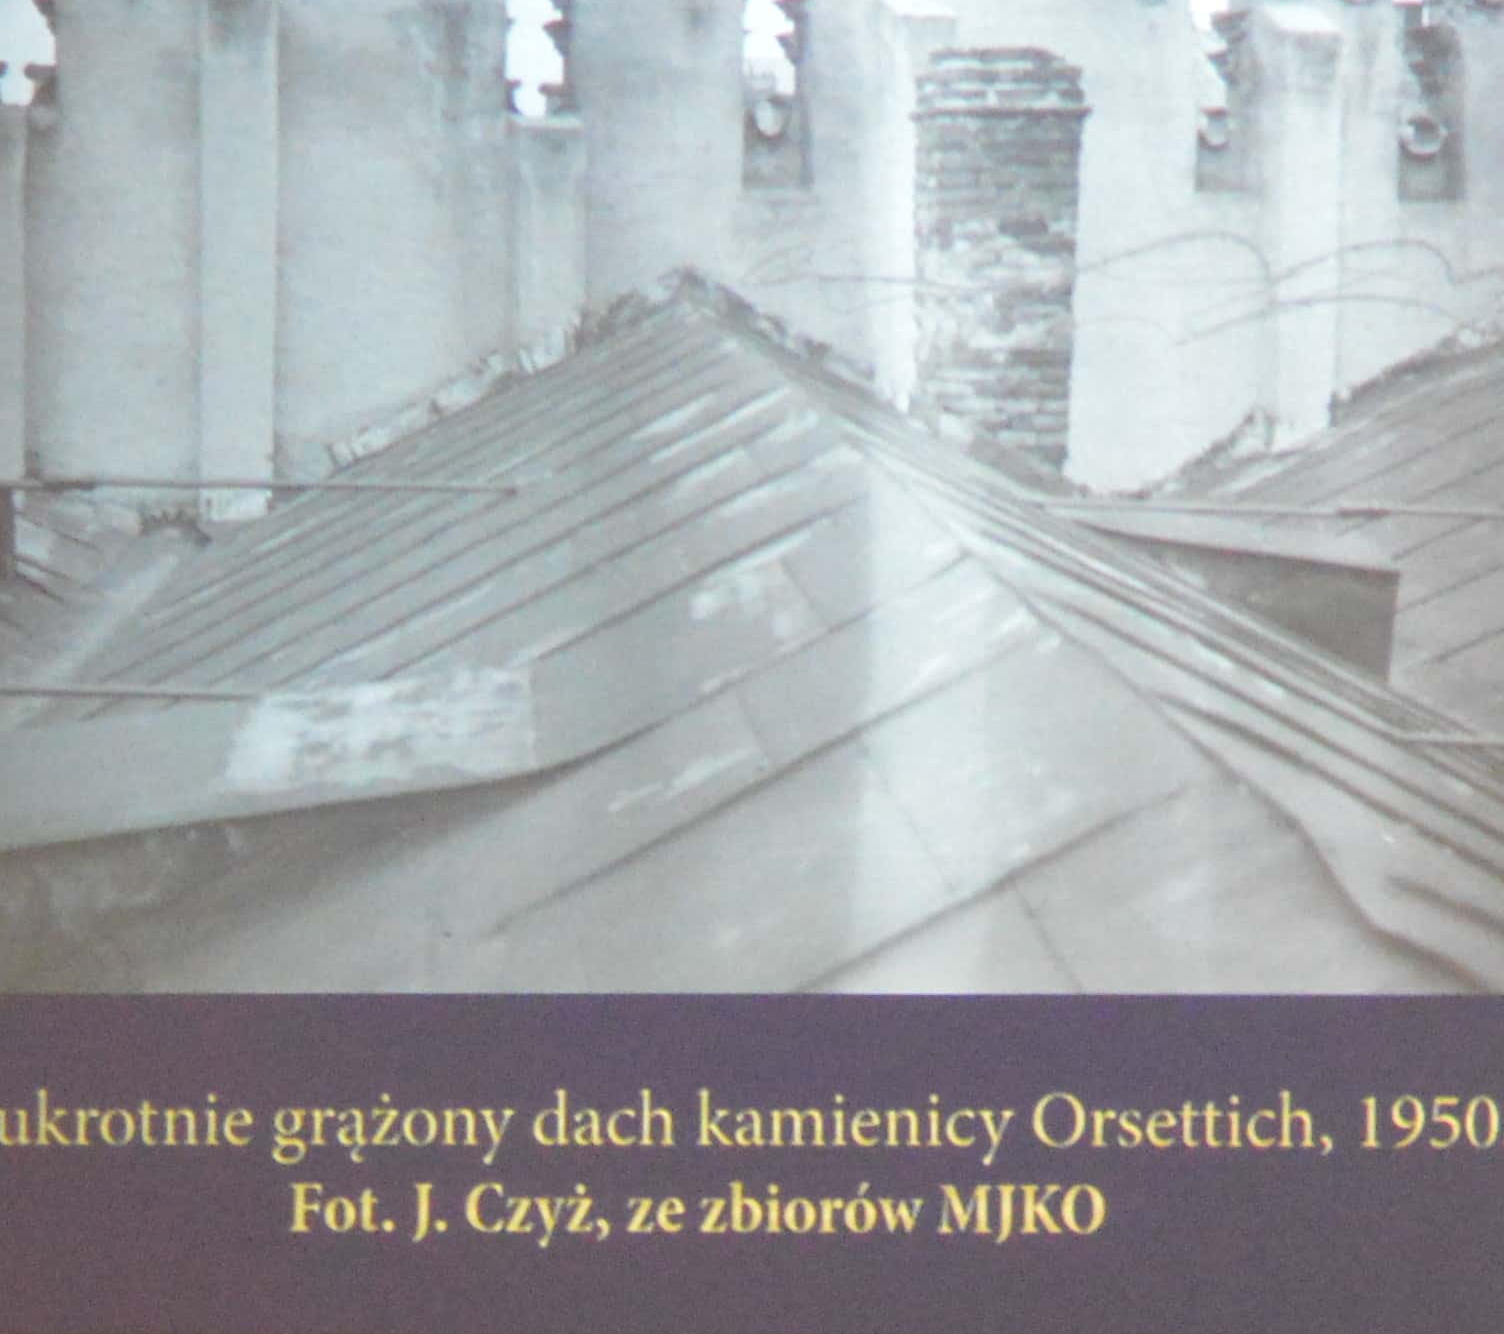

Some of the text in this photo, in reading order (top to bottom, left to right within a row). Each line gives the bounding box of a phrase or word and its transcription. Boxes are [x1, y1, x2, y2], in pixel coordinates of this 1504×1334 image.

[271, 1093, 515, 1164] grążony
[532, 1089, 675, 1146] dach
[697, 1089, 1015, 1165] kamienicy
[1031, 1089, 1335, 1154] Orsettich,
[289, 1181, 1106, 1247] Fot. J. Czyż, ze zbiorów MJKO
